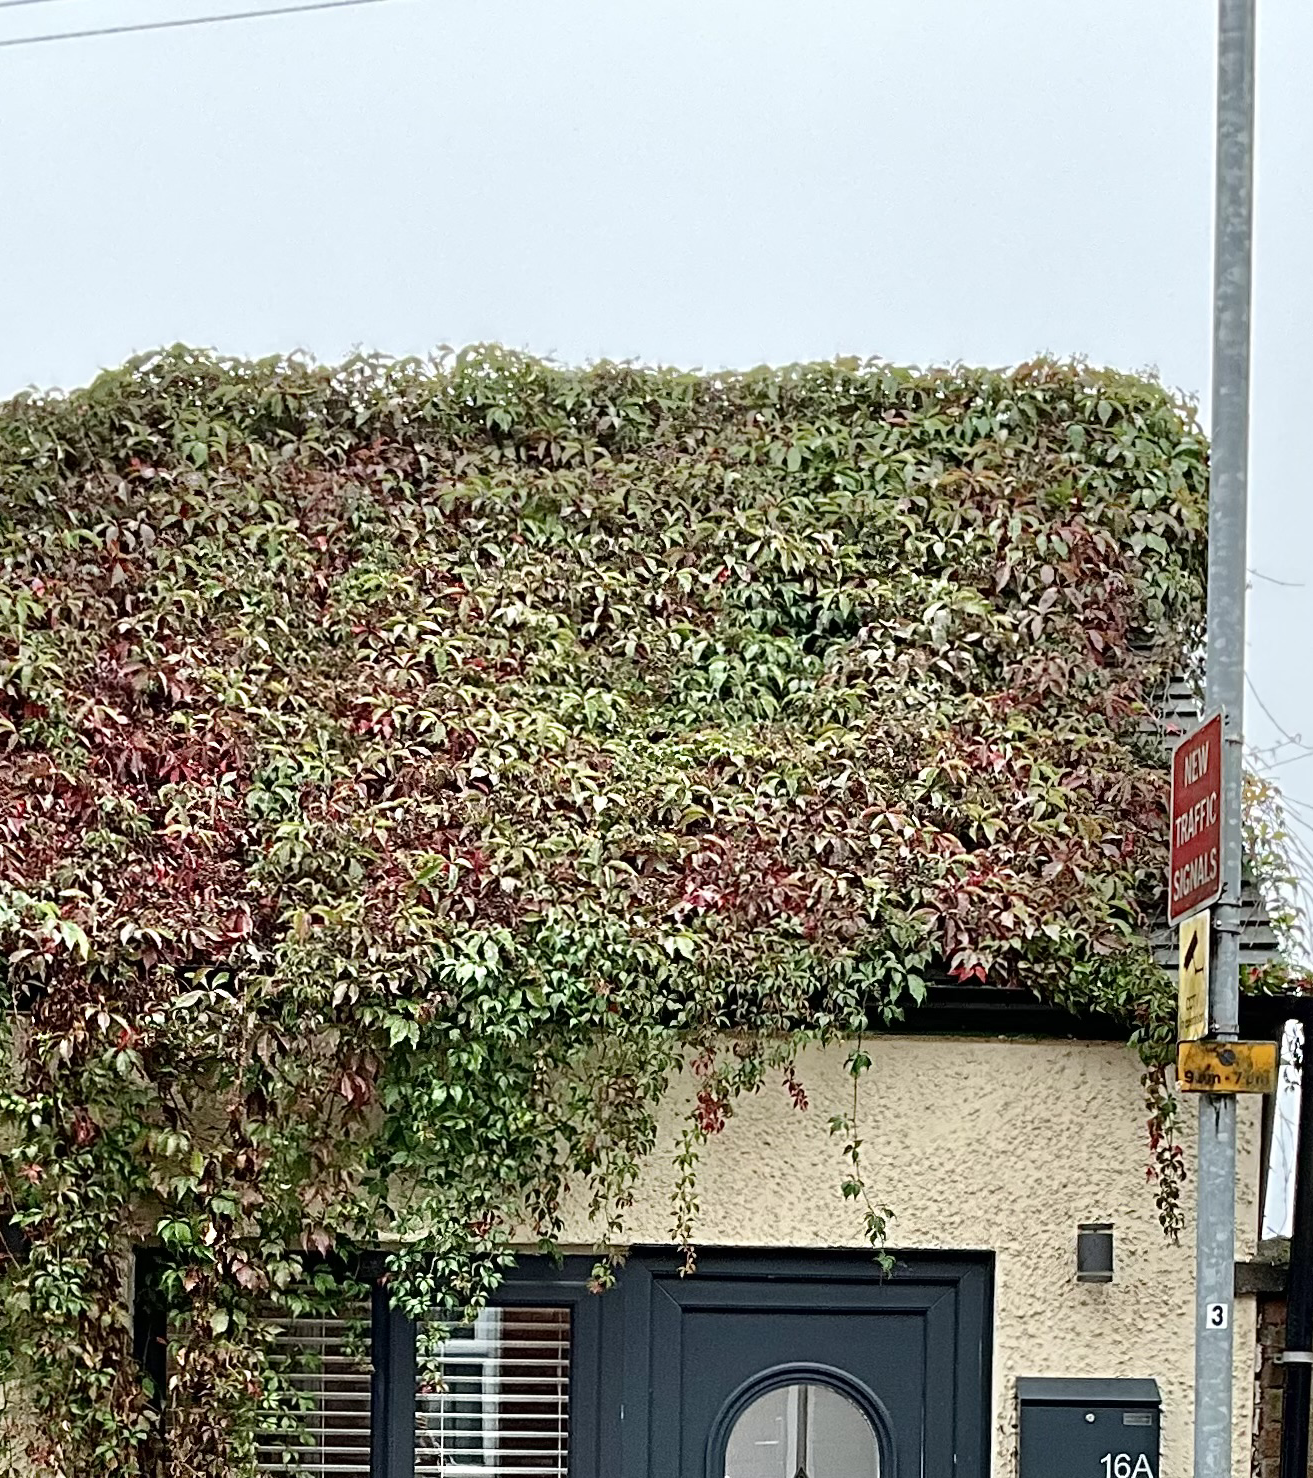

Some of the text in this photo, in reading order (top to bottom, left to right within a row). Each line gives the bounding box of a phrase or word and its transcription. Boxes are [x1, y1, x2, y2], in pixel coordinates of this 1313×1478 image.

[1185, 741, 1209, 787] NEW
[1175, 791, 1217, 848] TRAFFIC
[1173, 847, 1217, 901] SIGNALS
[1184, 1070, 1194, 1084] 9
[1232, 1071, 1242, 1084] 7
[1211, 1305, 1224, 1327] 3
